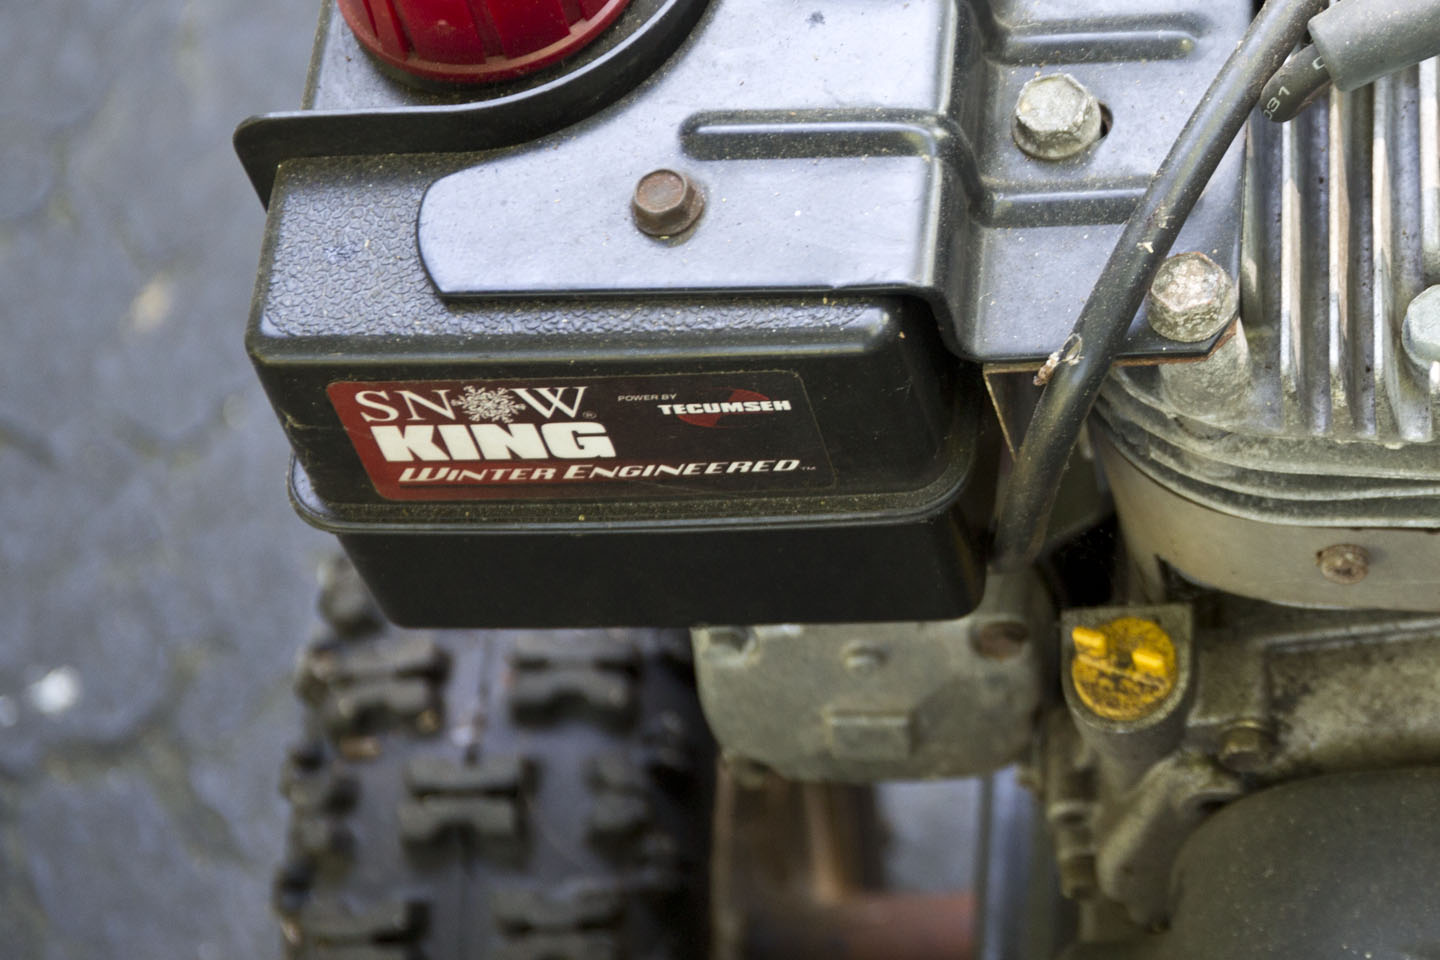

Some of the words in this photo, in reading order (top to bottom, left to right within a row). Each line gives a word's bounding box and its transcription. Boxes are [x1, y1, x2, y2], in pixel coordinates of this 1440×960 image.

[617, 393, 659, 402] POWER
[660, 392, 677, 401] BY
[657, 398, 792, 417] TECUMSEH
[370, 421, 617, 463] KING
[399, 464, 568, 483] WINTER
